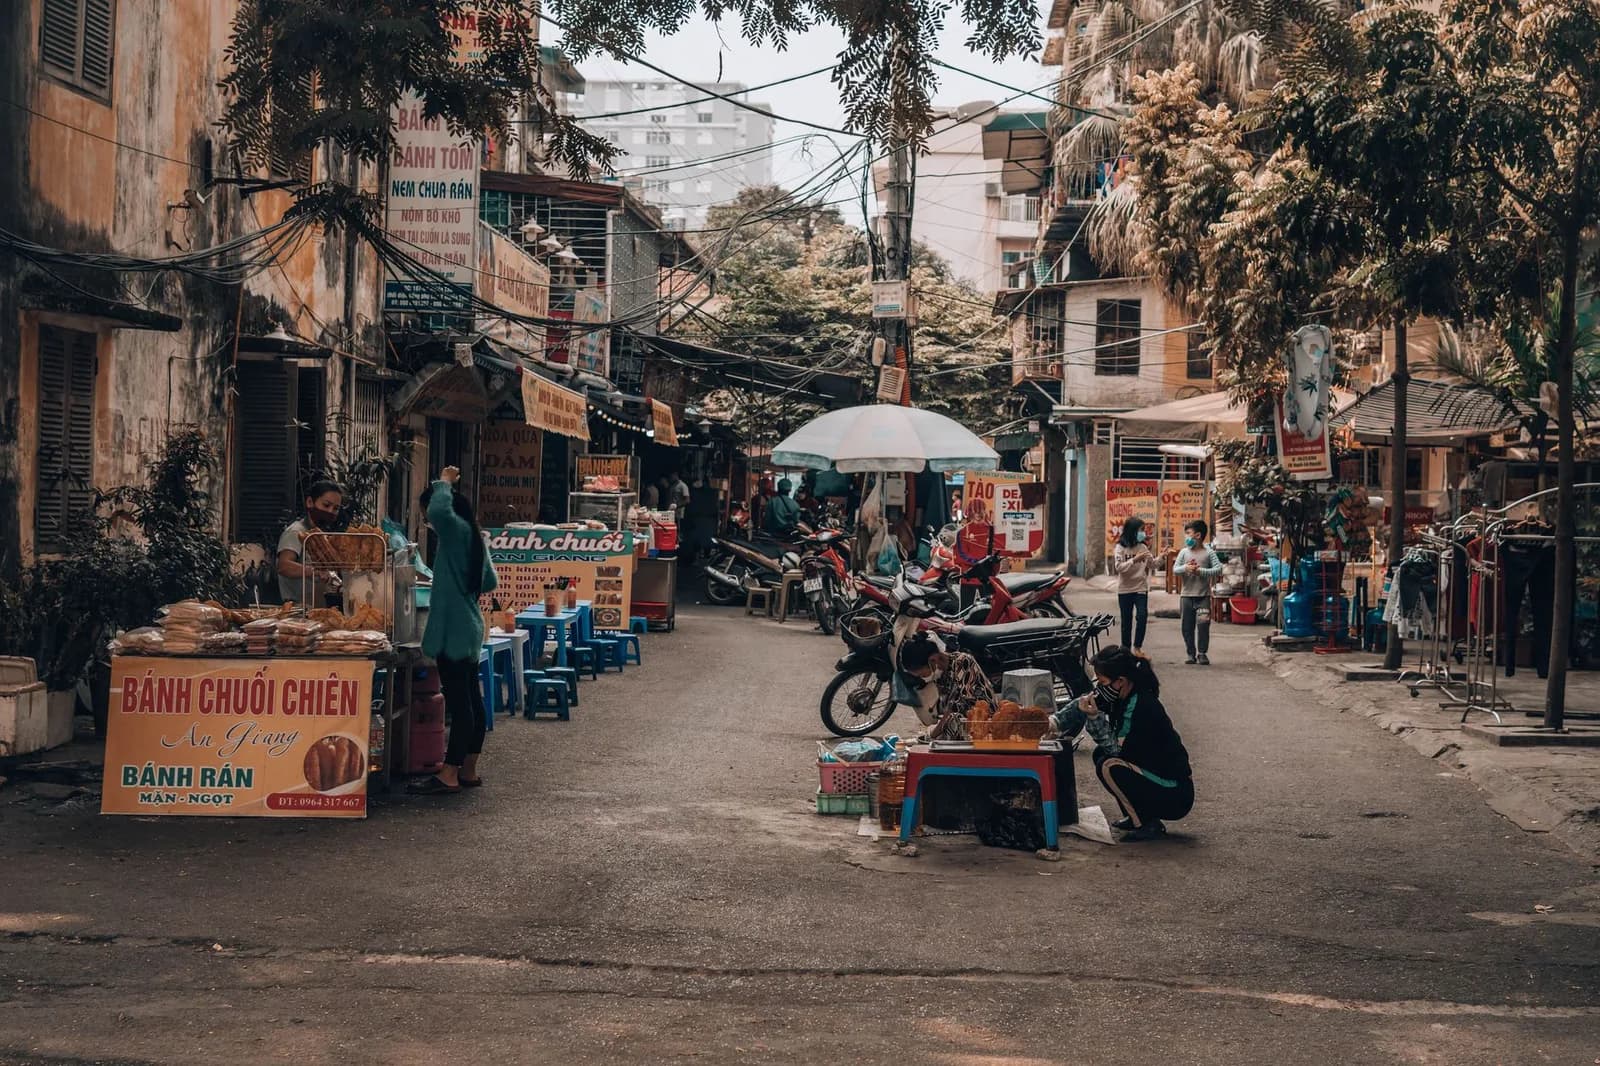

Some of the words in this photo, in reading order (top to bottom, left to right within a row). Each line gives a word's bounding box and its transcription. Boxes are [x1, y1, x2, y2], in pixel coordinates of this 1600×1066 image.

[393, 142, 436, 168] BÁNH
[440, 143, 473, 170] TÔM
[391, 180, 415, 198] NEM
[419, 180, 446, 199] CHUA
[450, 178, 472, 200] RÁN
[967, 478, 995, 499] TÀO
[551, 531, 625, 553] chuối
[532, 553, 607, 563] GIANG
[122, 670, 192, 714] BÁNH
[199, 666, 274, 716] CHUỐI
[281, 672, 360, 717] CHIÊN
[160, 722, 212, 748] An
[217, 720, 301, 758] Giang
[121, 762, 193, 788] BÁNH
[199, 763, 254, 789] RÁN
[138, 791, 176, 807] MẶN
[188, 793, 234, 807] NGỌT
[299, 798, 322, 806] 0964
[324, 798, 341, 806] 317
[343, 798, 360, 806] 667
